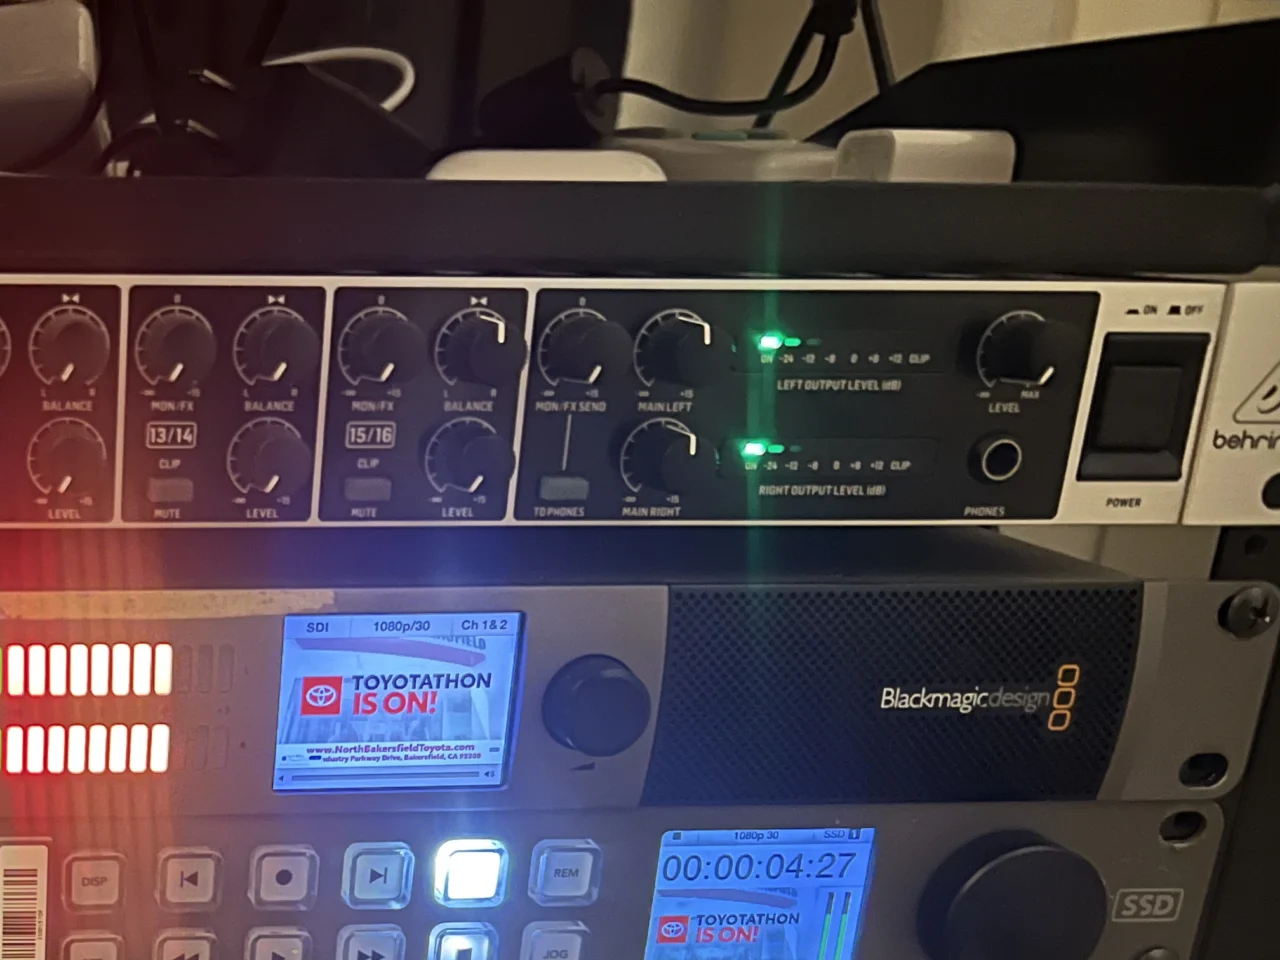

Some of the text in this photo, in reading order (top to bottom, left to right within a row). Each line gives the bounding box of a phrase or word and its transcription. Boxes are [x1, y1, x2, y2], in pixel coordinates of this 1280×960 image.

[778, 380, 804, 391] LEFT
[805, 380, 846, 391] OUTPUT
[848, 380, 878, 391] LEVEL
[42, 401, 92, 411] BALANCE
[245, 401, 294, 411] BALANCE
[444, 401, 493, 412] BALANCE
[578, 401, 606, 411] SEND
[638, 402, 692, 412] MAIN LEFT
[989, 404, 1020, 413] LEVEL
[150, 428, 193, 443] 13/14
[350, 428, 392, 443] 15/16
[759, 485, 790, 496] RIGHT
[790, 485, 832, 496] OUTPUT
[834, 485, 864, 496] LEVEL
[1106, 498, 1141, 508] POWER
[48, 509, 80, 520] LEVEL
[247, 509, 278, 520] LEVEL
[442, 508, 474, 518] LEVEL
[546, 507, 584, 517] PHONES
[622, 508, 680, 517] MAIN RIGHT
[964, 506, 1005, 516] PHONES
[306, 623, 328, 632] SDI
[374, 620, 430, 633] 1080p/30
[462, 620, 478, 630] Ch
[352, 673, 491, 690] TOYOTATHON
[353, 691, 438, 714] IS ON!
[734, 831, 779, 840] 1080p 30
[824, 830, 845, 838] SSD
[663, 853, 856, 880] 00:00:04:27
[554, 868, 578, 879] REM
[82, 876, 108, 888] DISP
[1121, 895, 1174, 916] SSD
[696, 913, 800, 926] TOYOTATHON
[696, 927, 759, 942] IS ON!
[543, 949, 568, 960] JOG
